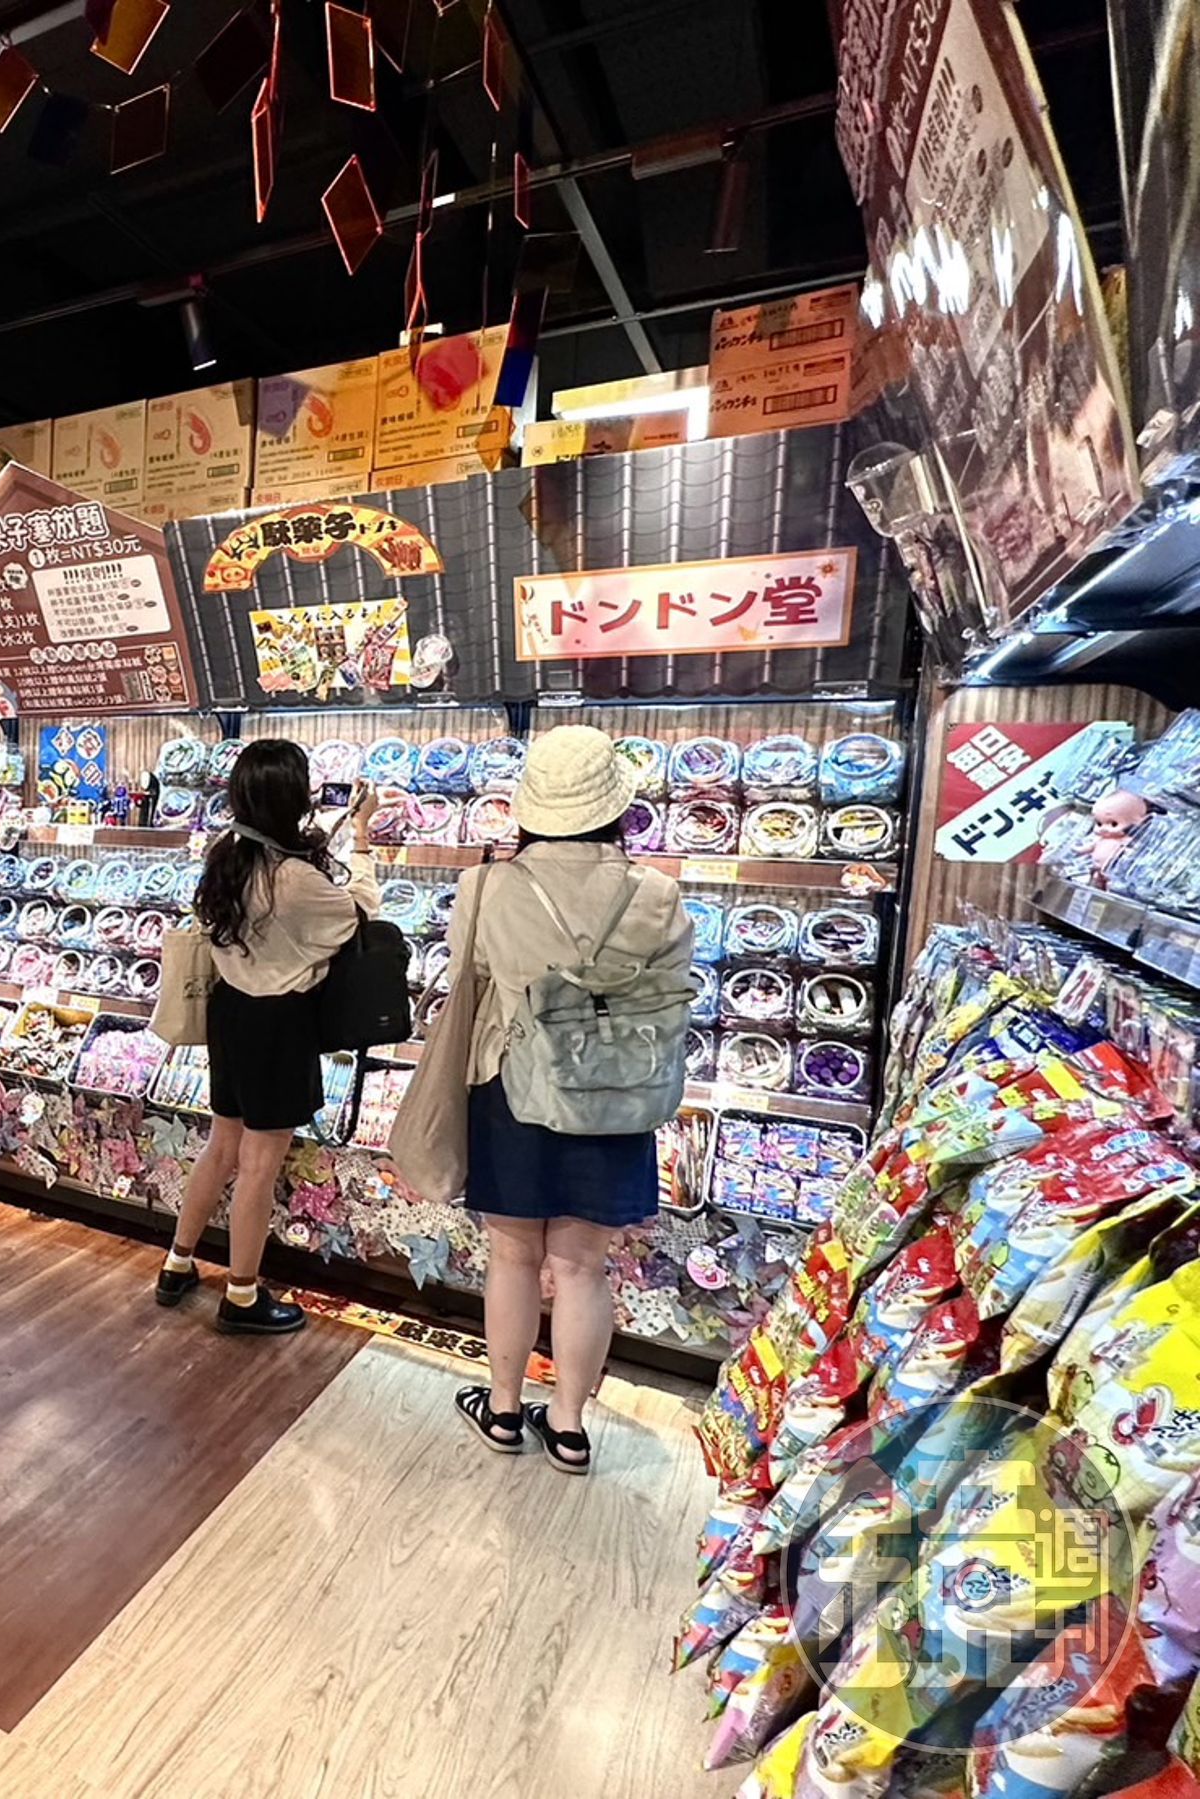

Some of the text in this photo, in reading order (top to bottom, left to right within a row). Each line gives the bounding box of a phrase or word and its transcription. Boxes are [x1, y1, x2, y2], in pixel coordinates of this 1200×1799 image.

[550, 575, 823, 635] ドンドン堂
